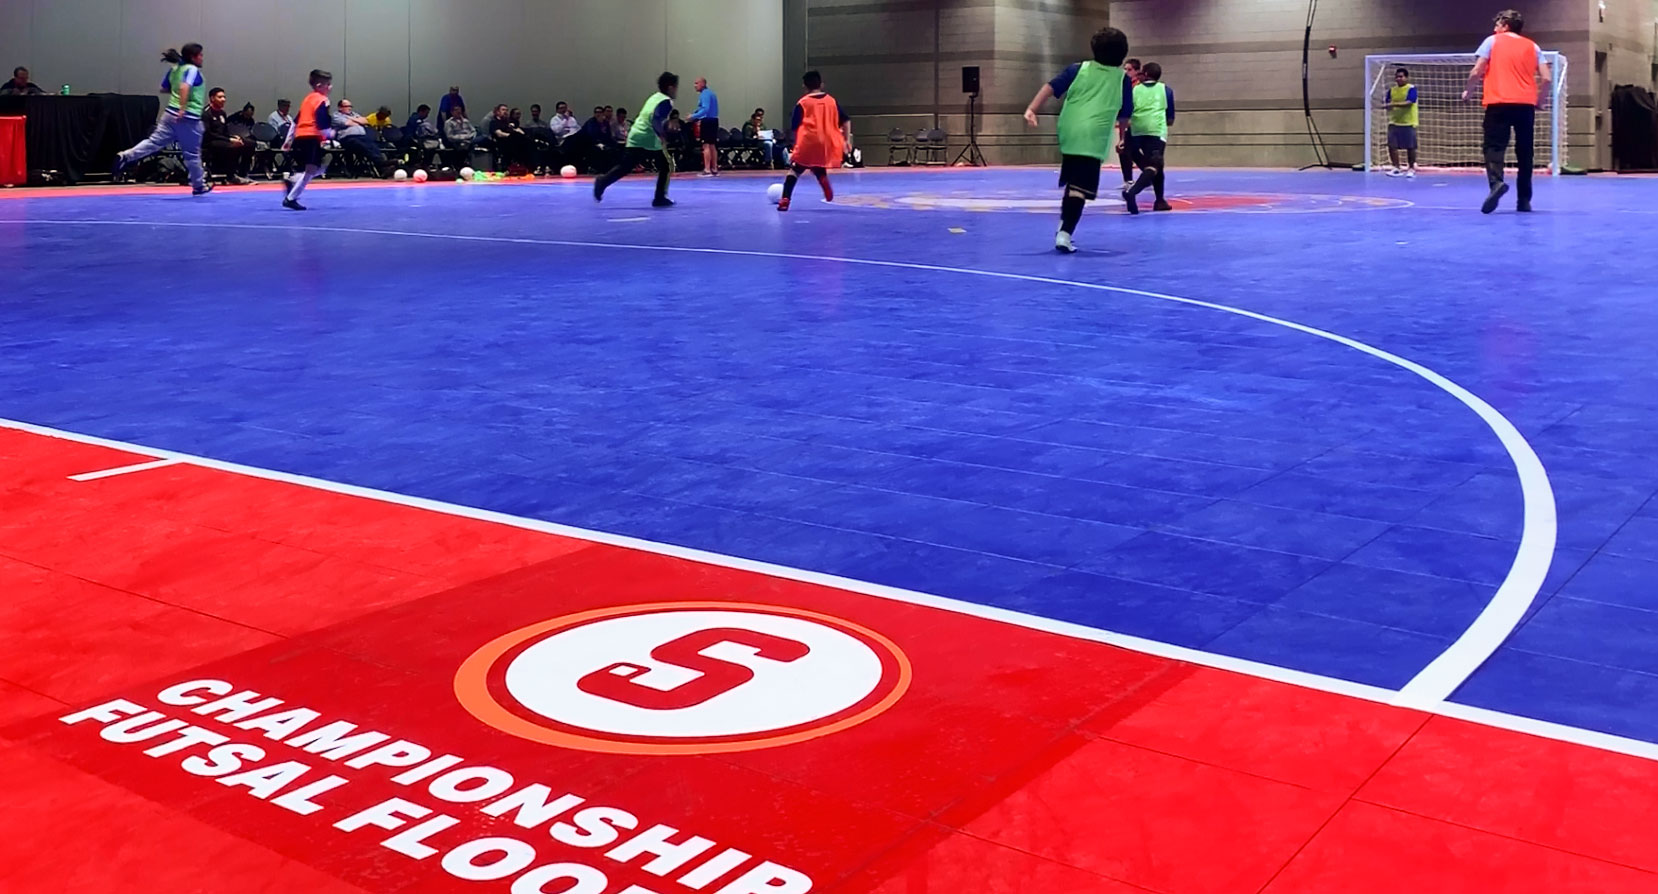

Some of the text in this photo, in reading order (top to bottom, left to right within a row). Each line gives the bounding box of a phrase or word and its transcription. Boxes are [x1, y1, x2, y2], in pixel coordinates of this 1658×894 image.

[577, 628, 810, 710] S
[59, 699, 658, 894] FUTSAL FLOO
[158, 680, 812, 894] CHAMPIONSHIP
